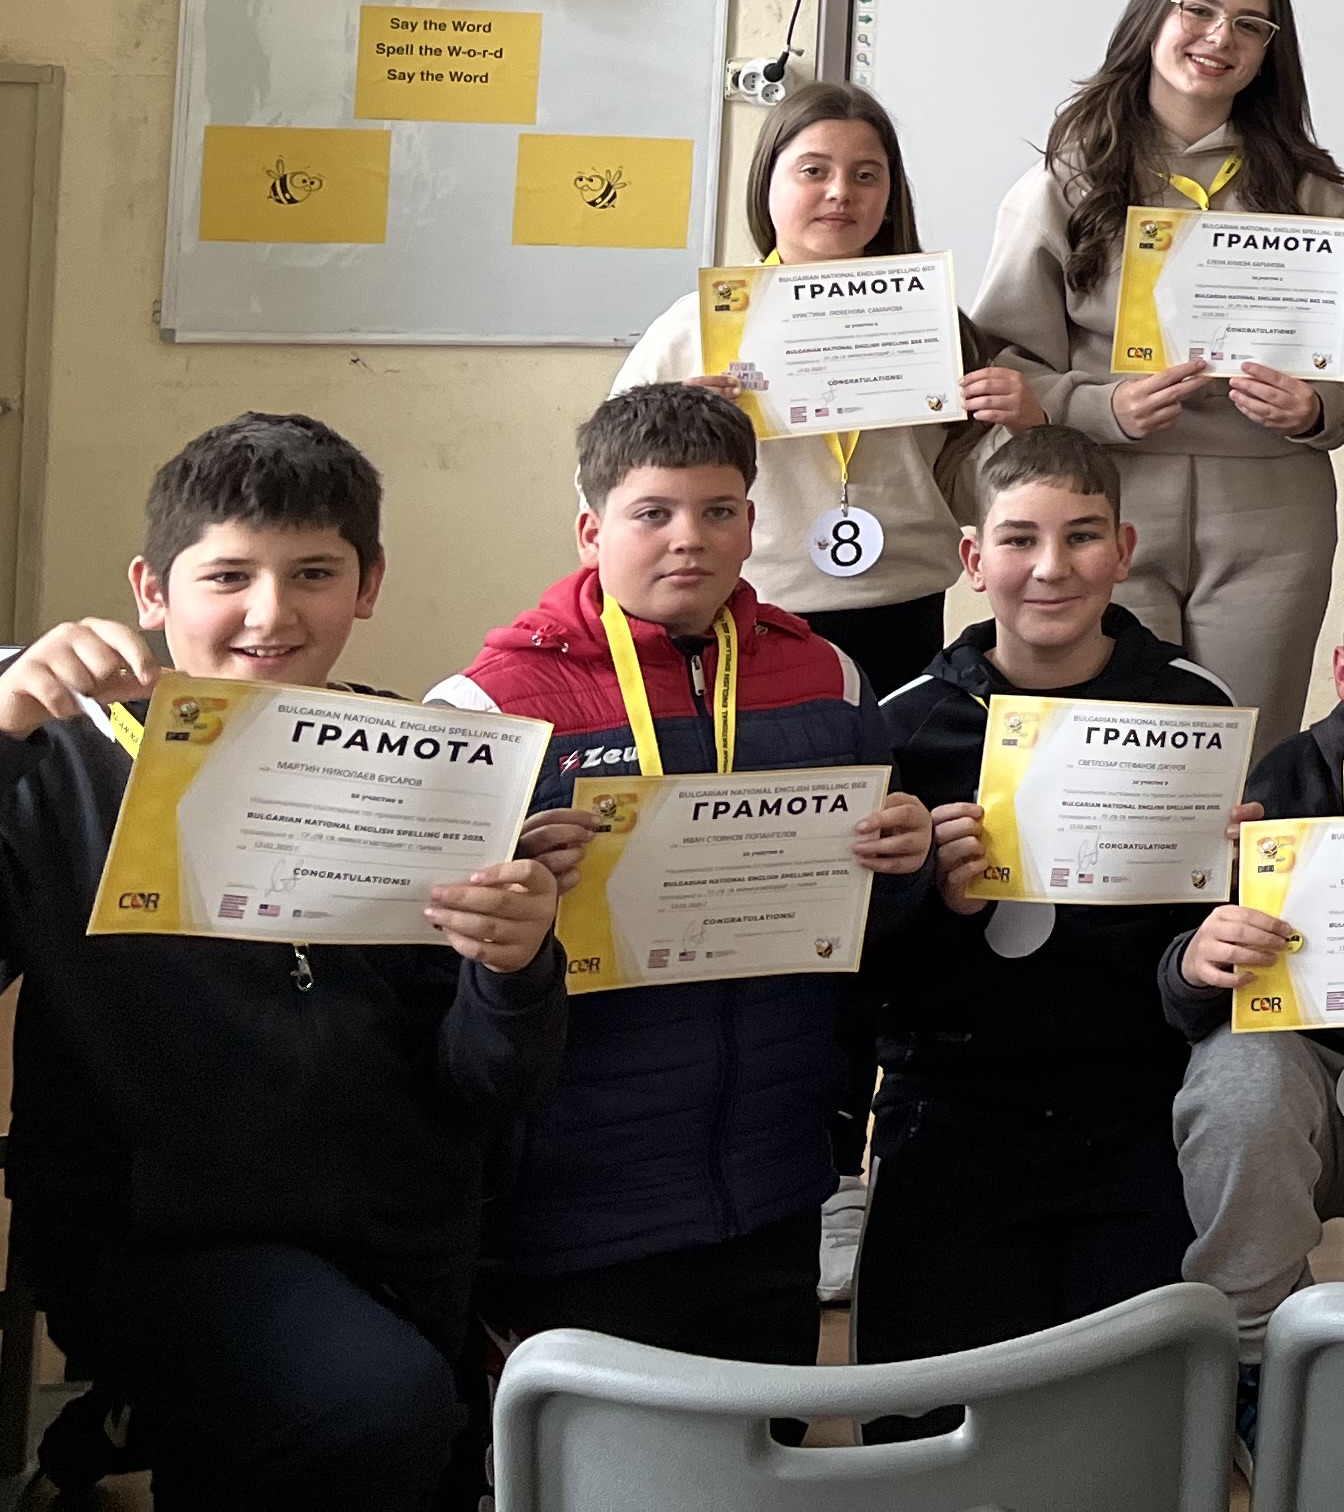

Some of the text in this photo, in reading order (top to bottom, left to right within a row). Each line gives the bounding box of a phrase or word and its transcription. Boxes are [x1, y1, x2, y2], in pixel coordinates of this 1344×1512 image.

[390, 18, 492, 33] Say the Word
[376, 43, 503, 58] Spell the W-o-r-d
[387, 69, 489, 83] Say the Word
[1213, 232, 1333, 254] ГРАМОТА
[793, 276, 925, 301] ГРАМОТА
[830, 519, 863, 567] 8
[278, 704, 522, 744] BULGARIAN NATIONAL ENGLISH SPELLING BEE
[291, 720, 494, 766] ГРАМОТА
[1085, 727, 1223, 750] ГРАМОТА
[692, 793, 849, 820] ГРАМОТА
[292, 867, 412, 887] CONGRATULATIONS!
